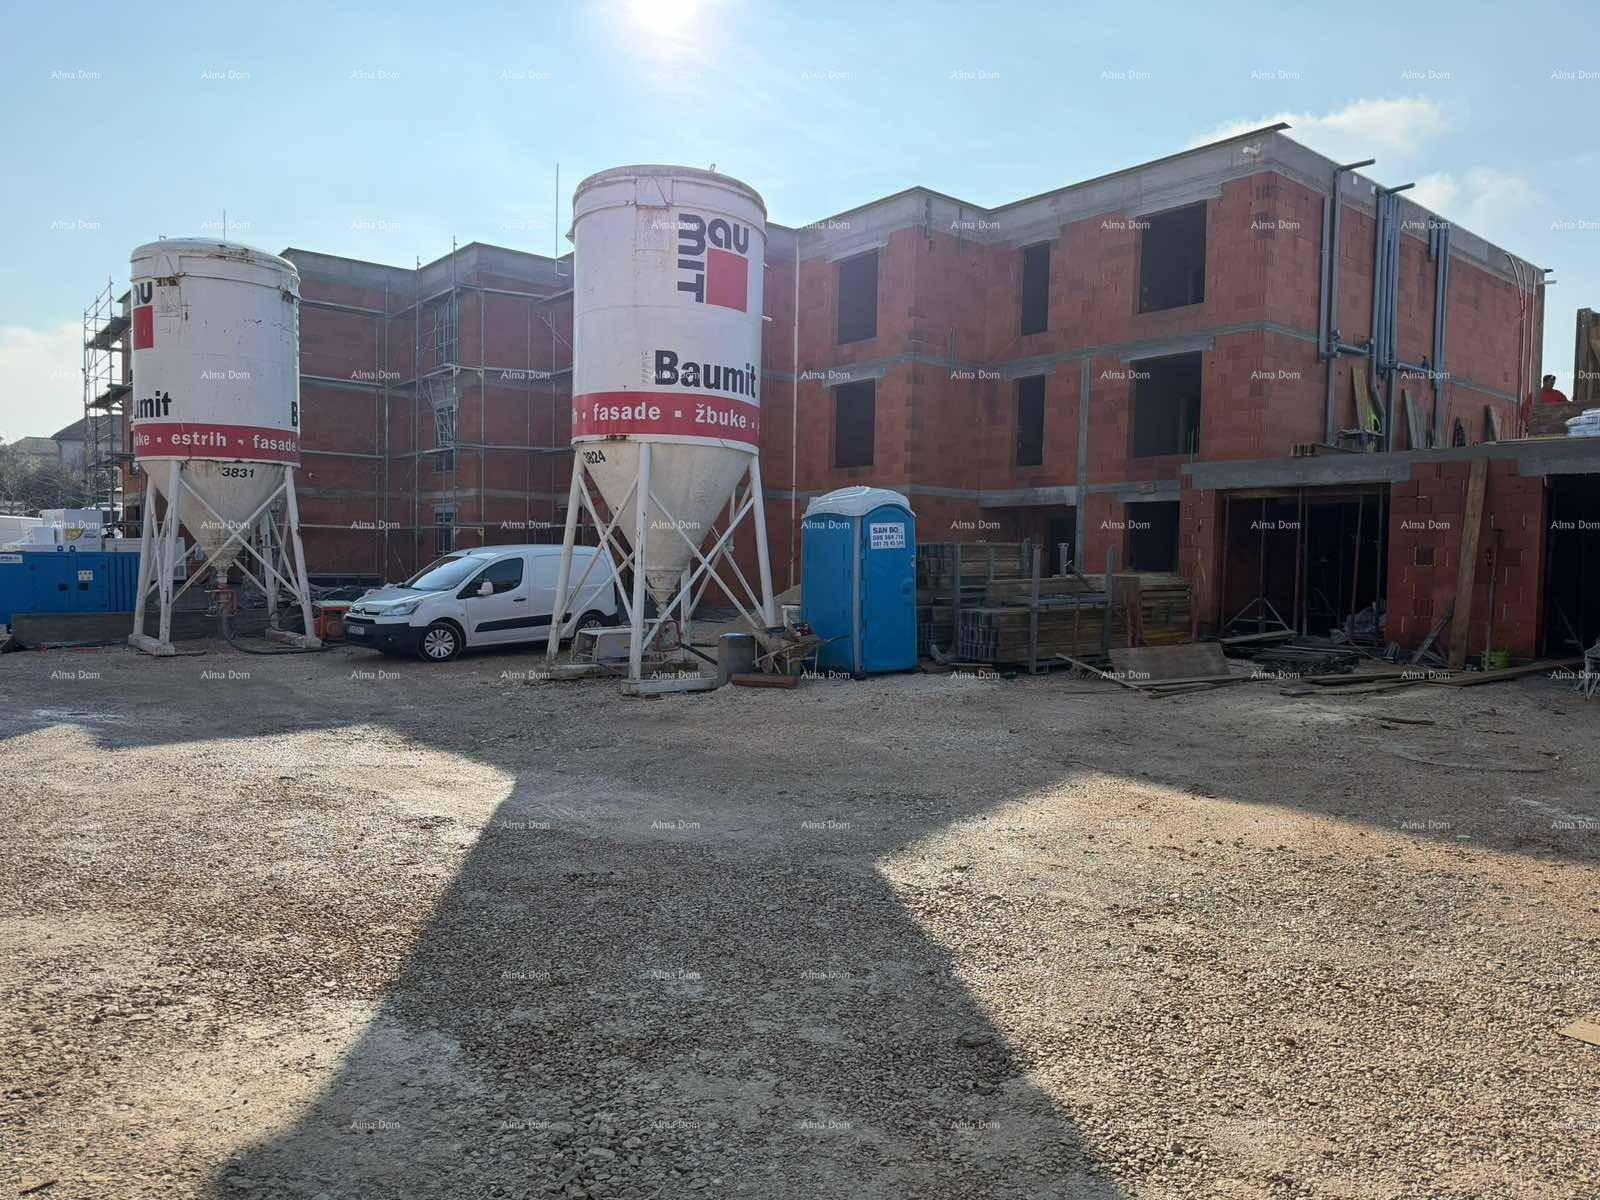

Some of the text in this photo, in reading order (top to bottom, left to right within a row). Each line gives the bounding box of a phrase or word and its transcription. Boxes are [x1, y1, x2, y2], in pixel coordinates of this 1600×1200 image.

[654, 349, 757, 399] Baumit
[593, 402, 662, 422] fasade
[695, 403, 747, 429] žbuke
[171, 431, 227, 447] estrih
[252, 434, 297, 453] fasade
[221, 467, 255, 479] 3831
